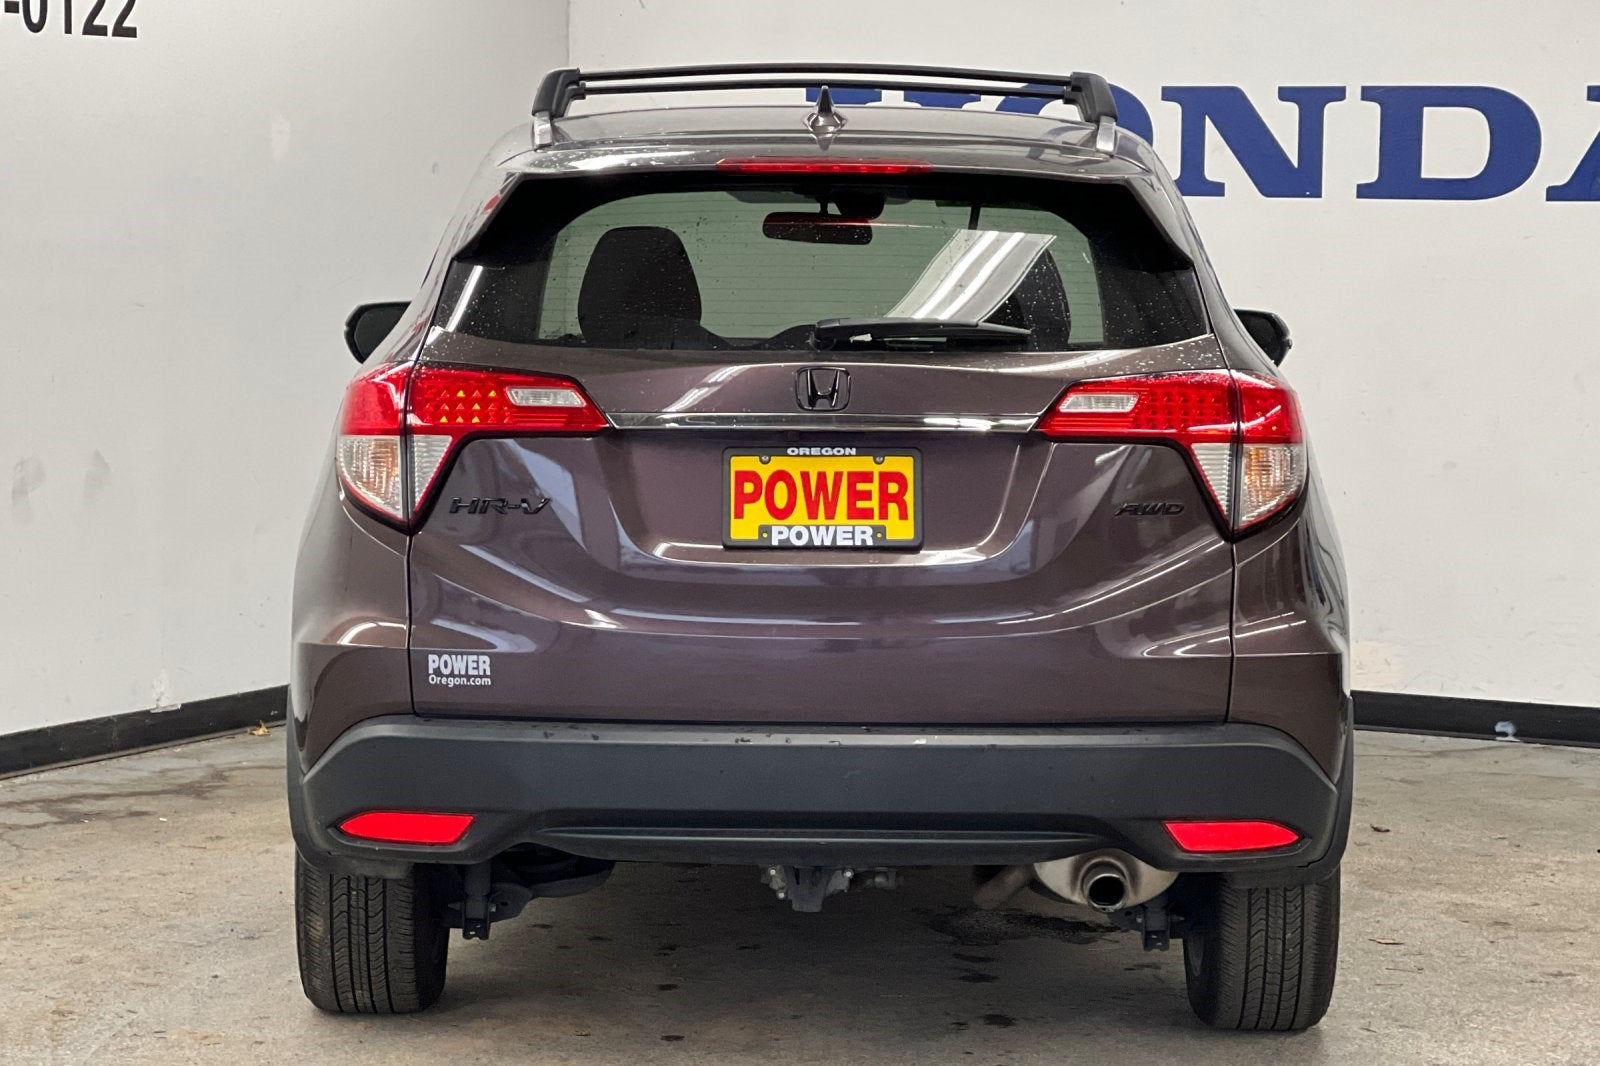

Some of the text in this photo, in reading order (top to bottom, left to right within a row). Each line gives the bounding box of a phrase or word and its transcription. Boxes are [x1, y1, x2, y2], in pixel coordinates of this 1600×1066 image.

[806, 82, 1600, 202] OND
[786, 447, 857, 456] OREGON
[733, 469, 909, 521] POWER
[449, 497, 551, 515] HR-V
[1114, 502, 1185, 517] AWD
[771, 525, 874, 546] POWER
[428, 654, 491, 675] POWER
[428, 674, 492, 688] Oregon.com
